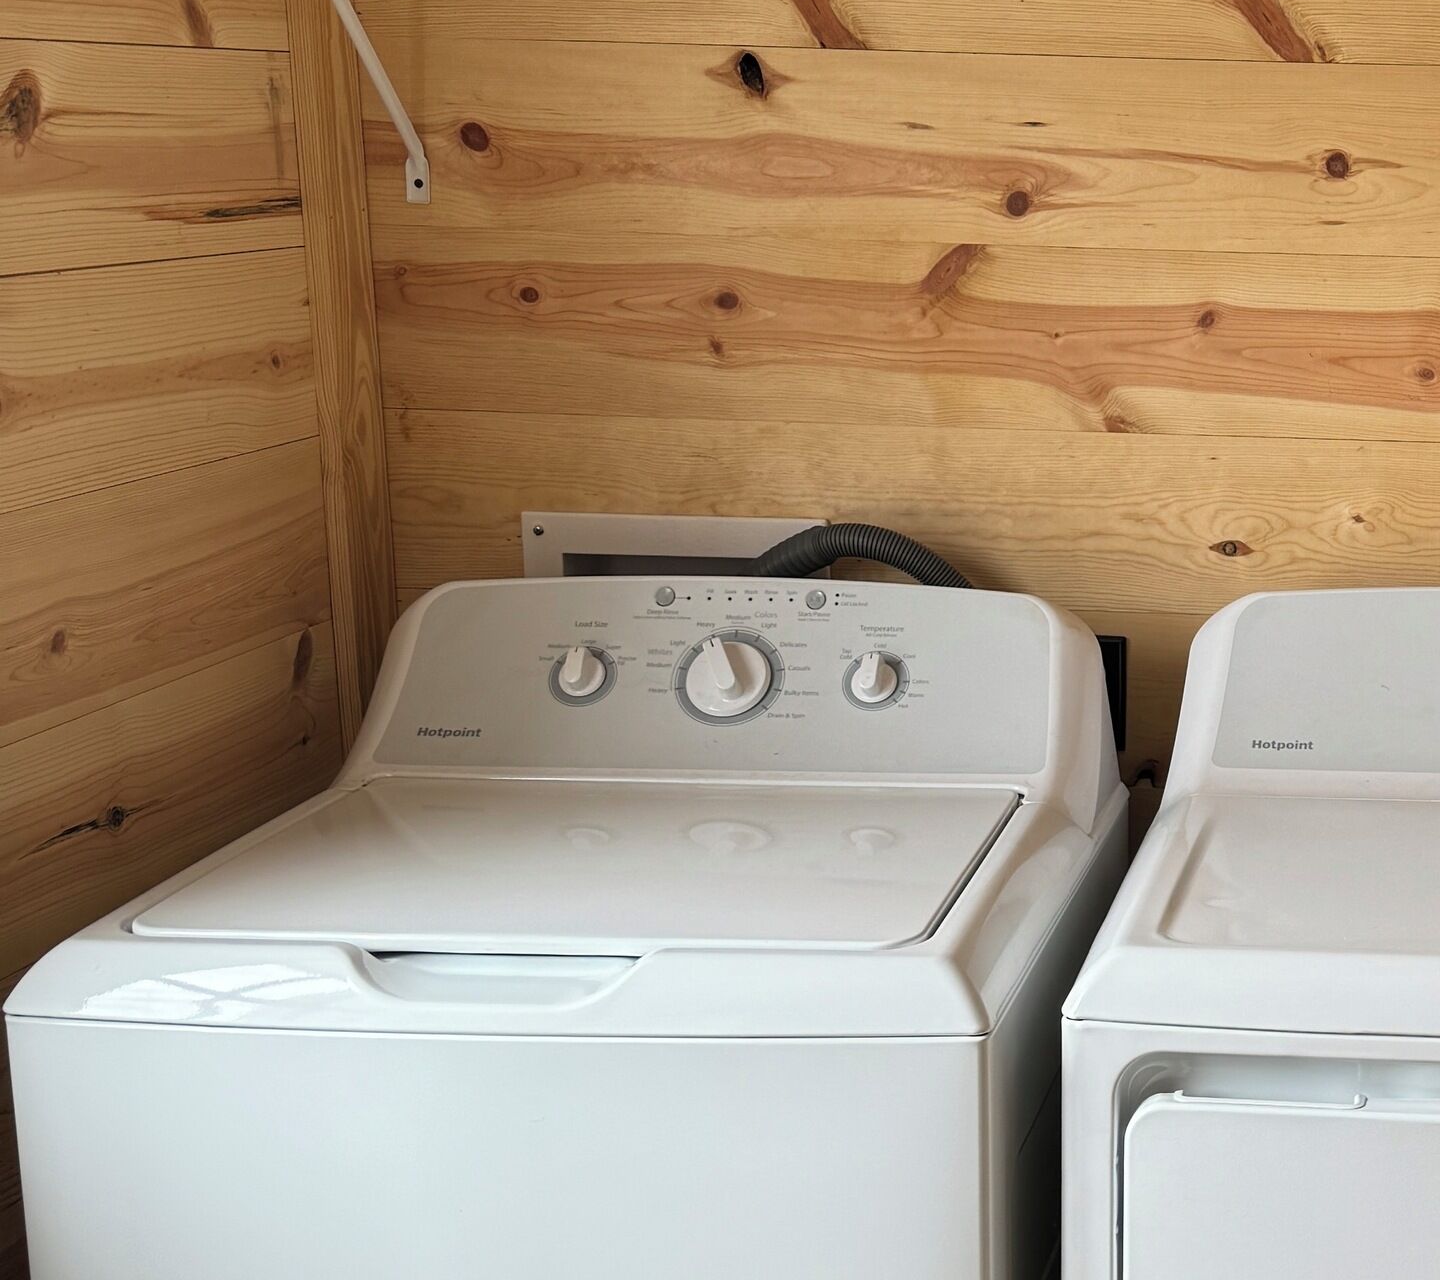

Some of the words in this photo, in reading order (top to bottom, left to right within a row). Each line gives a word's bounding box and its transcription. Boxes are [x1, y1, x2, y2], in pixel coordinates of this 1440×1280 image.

[860, 625, 904, 633] Temperature
[417, 727, 482, 738] Hotpoint
[1252, 740, 1314, 751] Hotpoint
